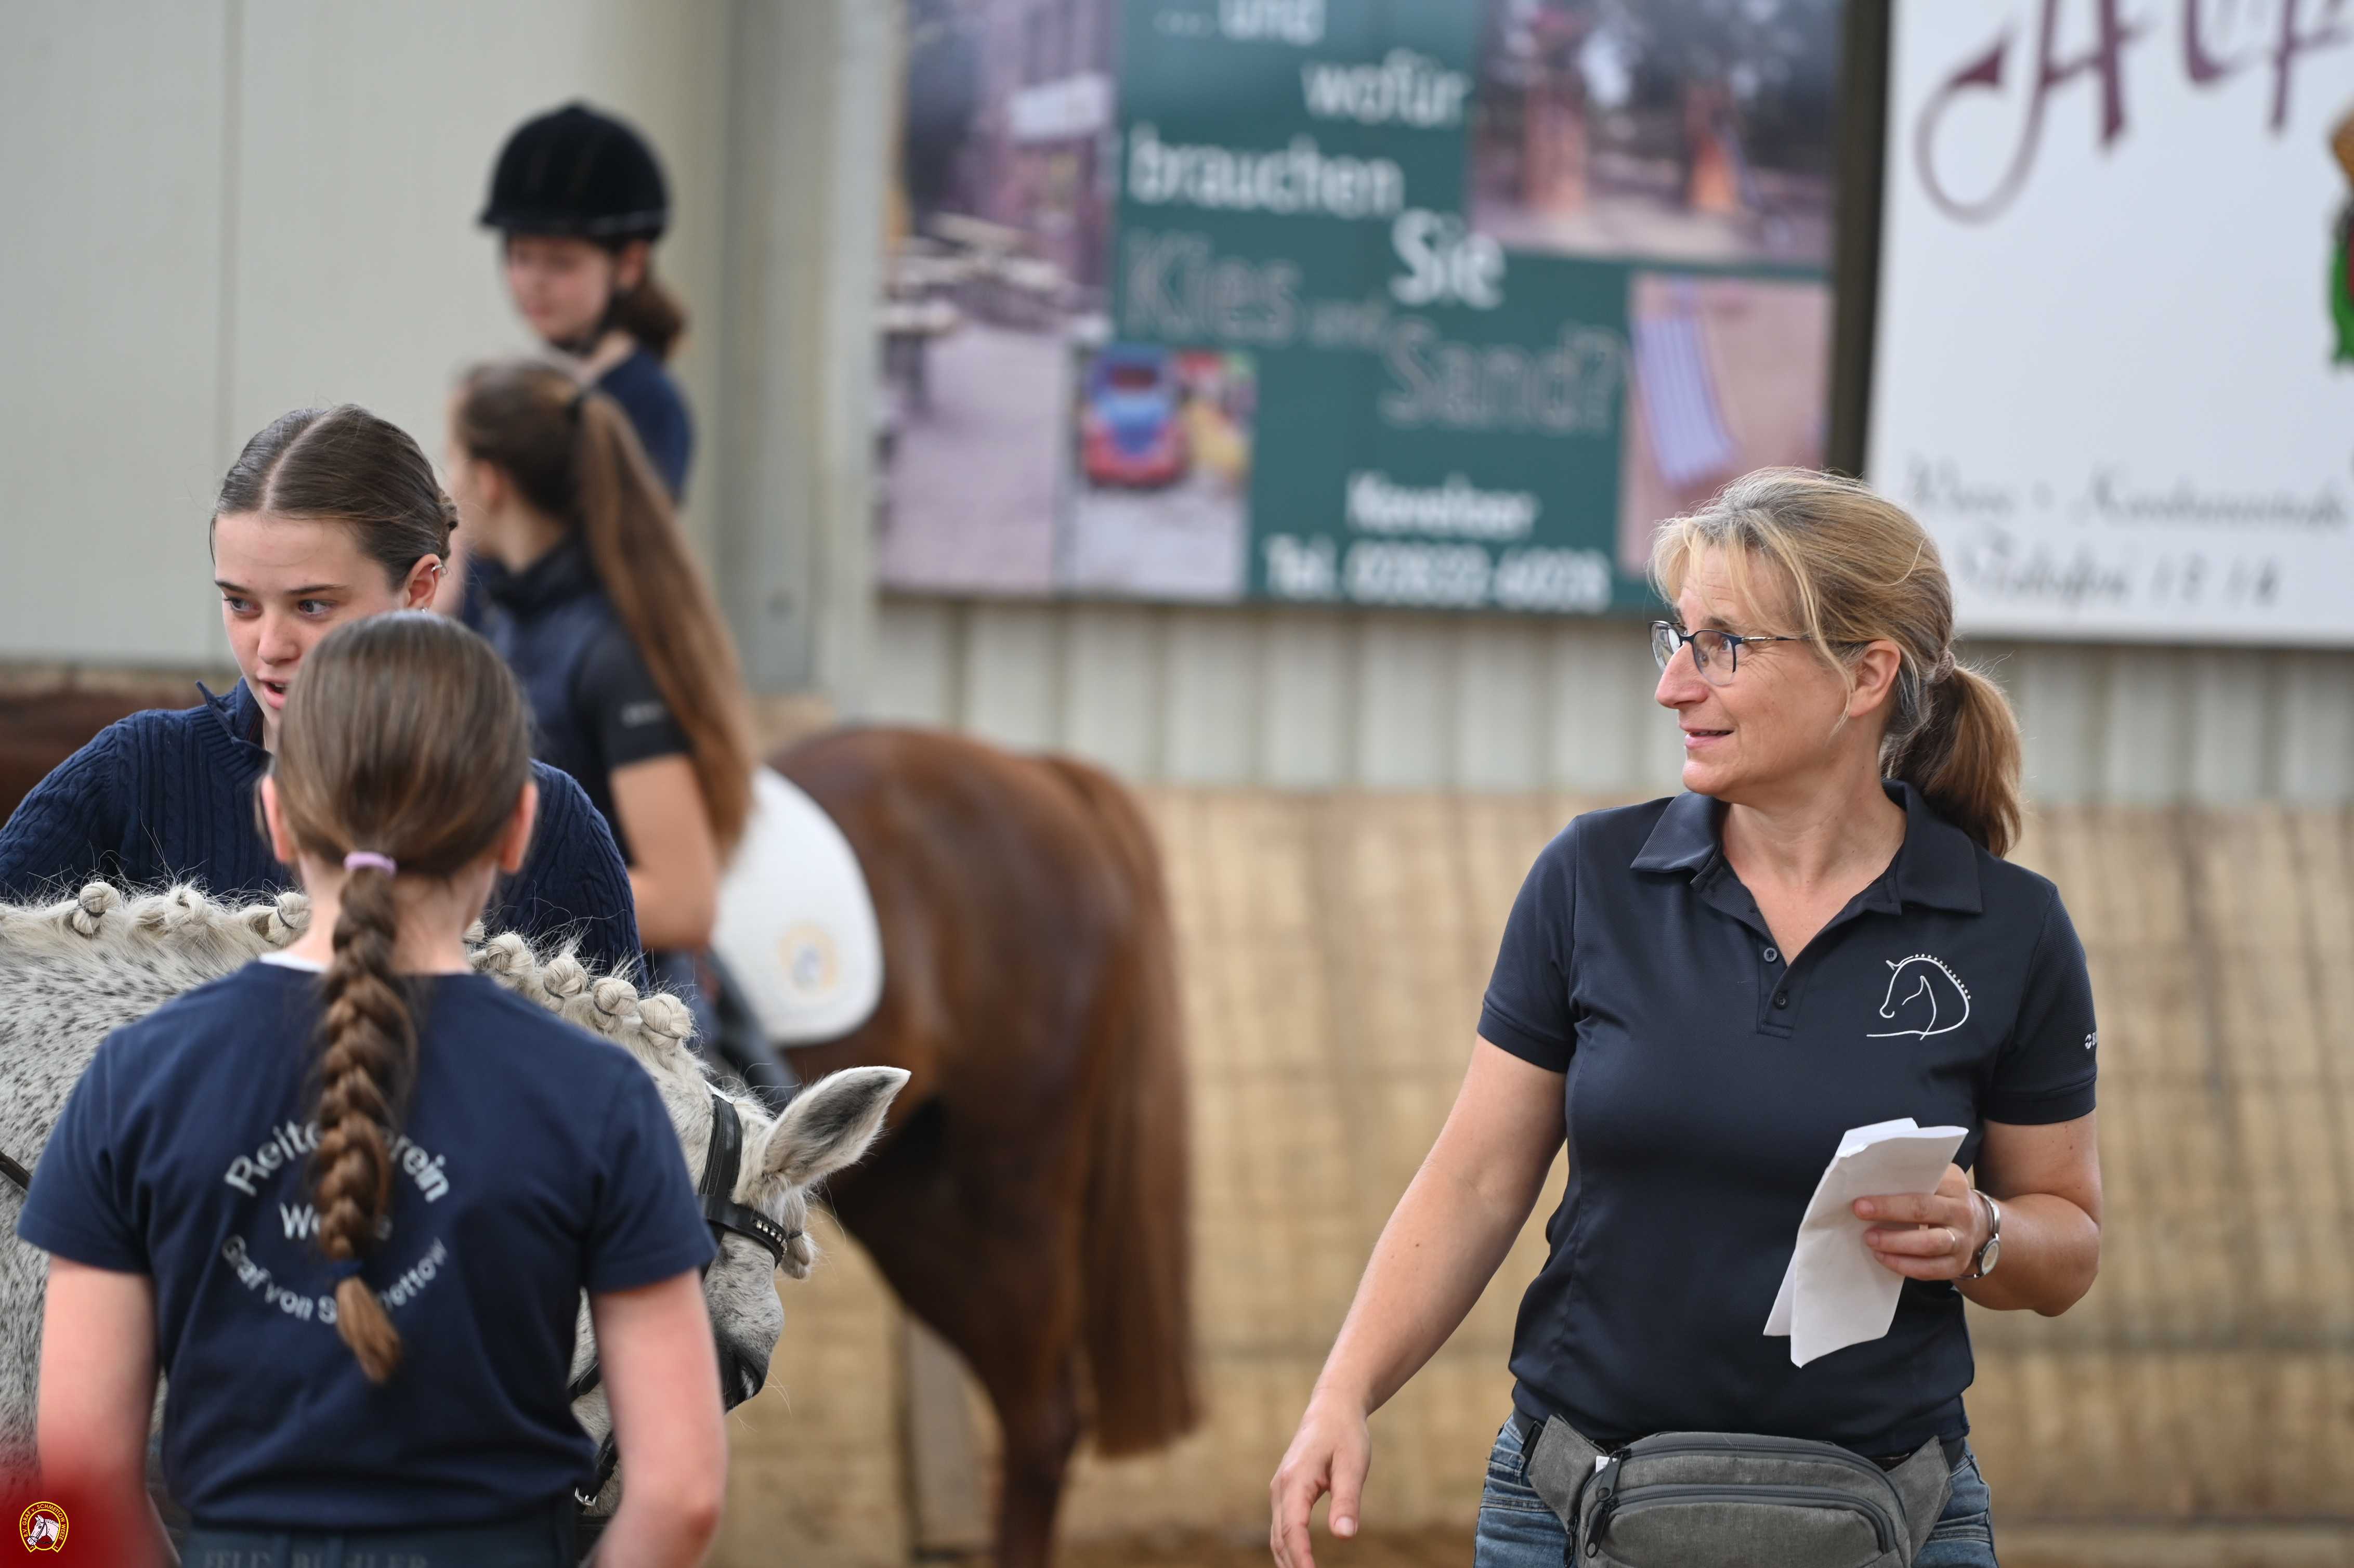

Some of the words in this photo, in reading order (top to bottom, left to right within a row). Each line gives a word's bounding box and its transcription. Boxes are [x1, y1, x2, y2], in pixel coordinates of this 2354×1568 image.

[1301, 51, 1469, 126] wofür
[1129, 122, 1405, 217] brauchen
[1124, 231, 1302, 343] Kies
[1389, 209, 1506, 310] Sie
[264, 1285, 314, 1322] von
